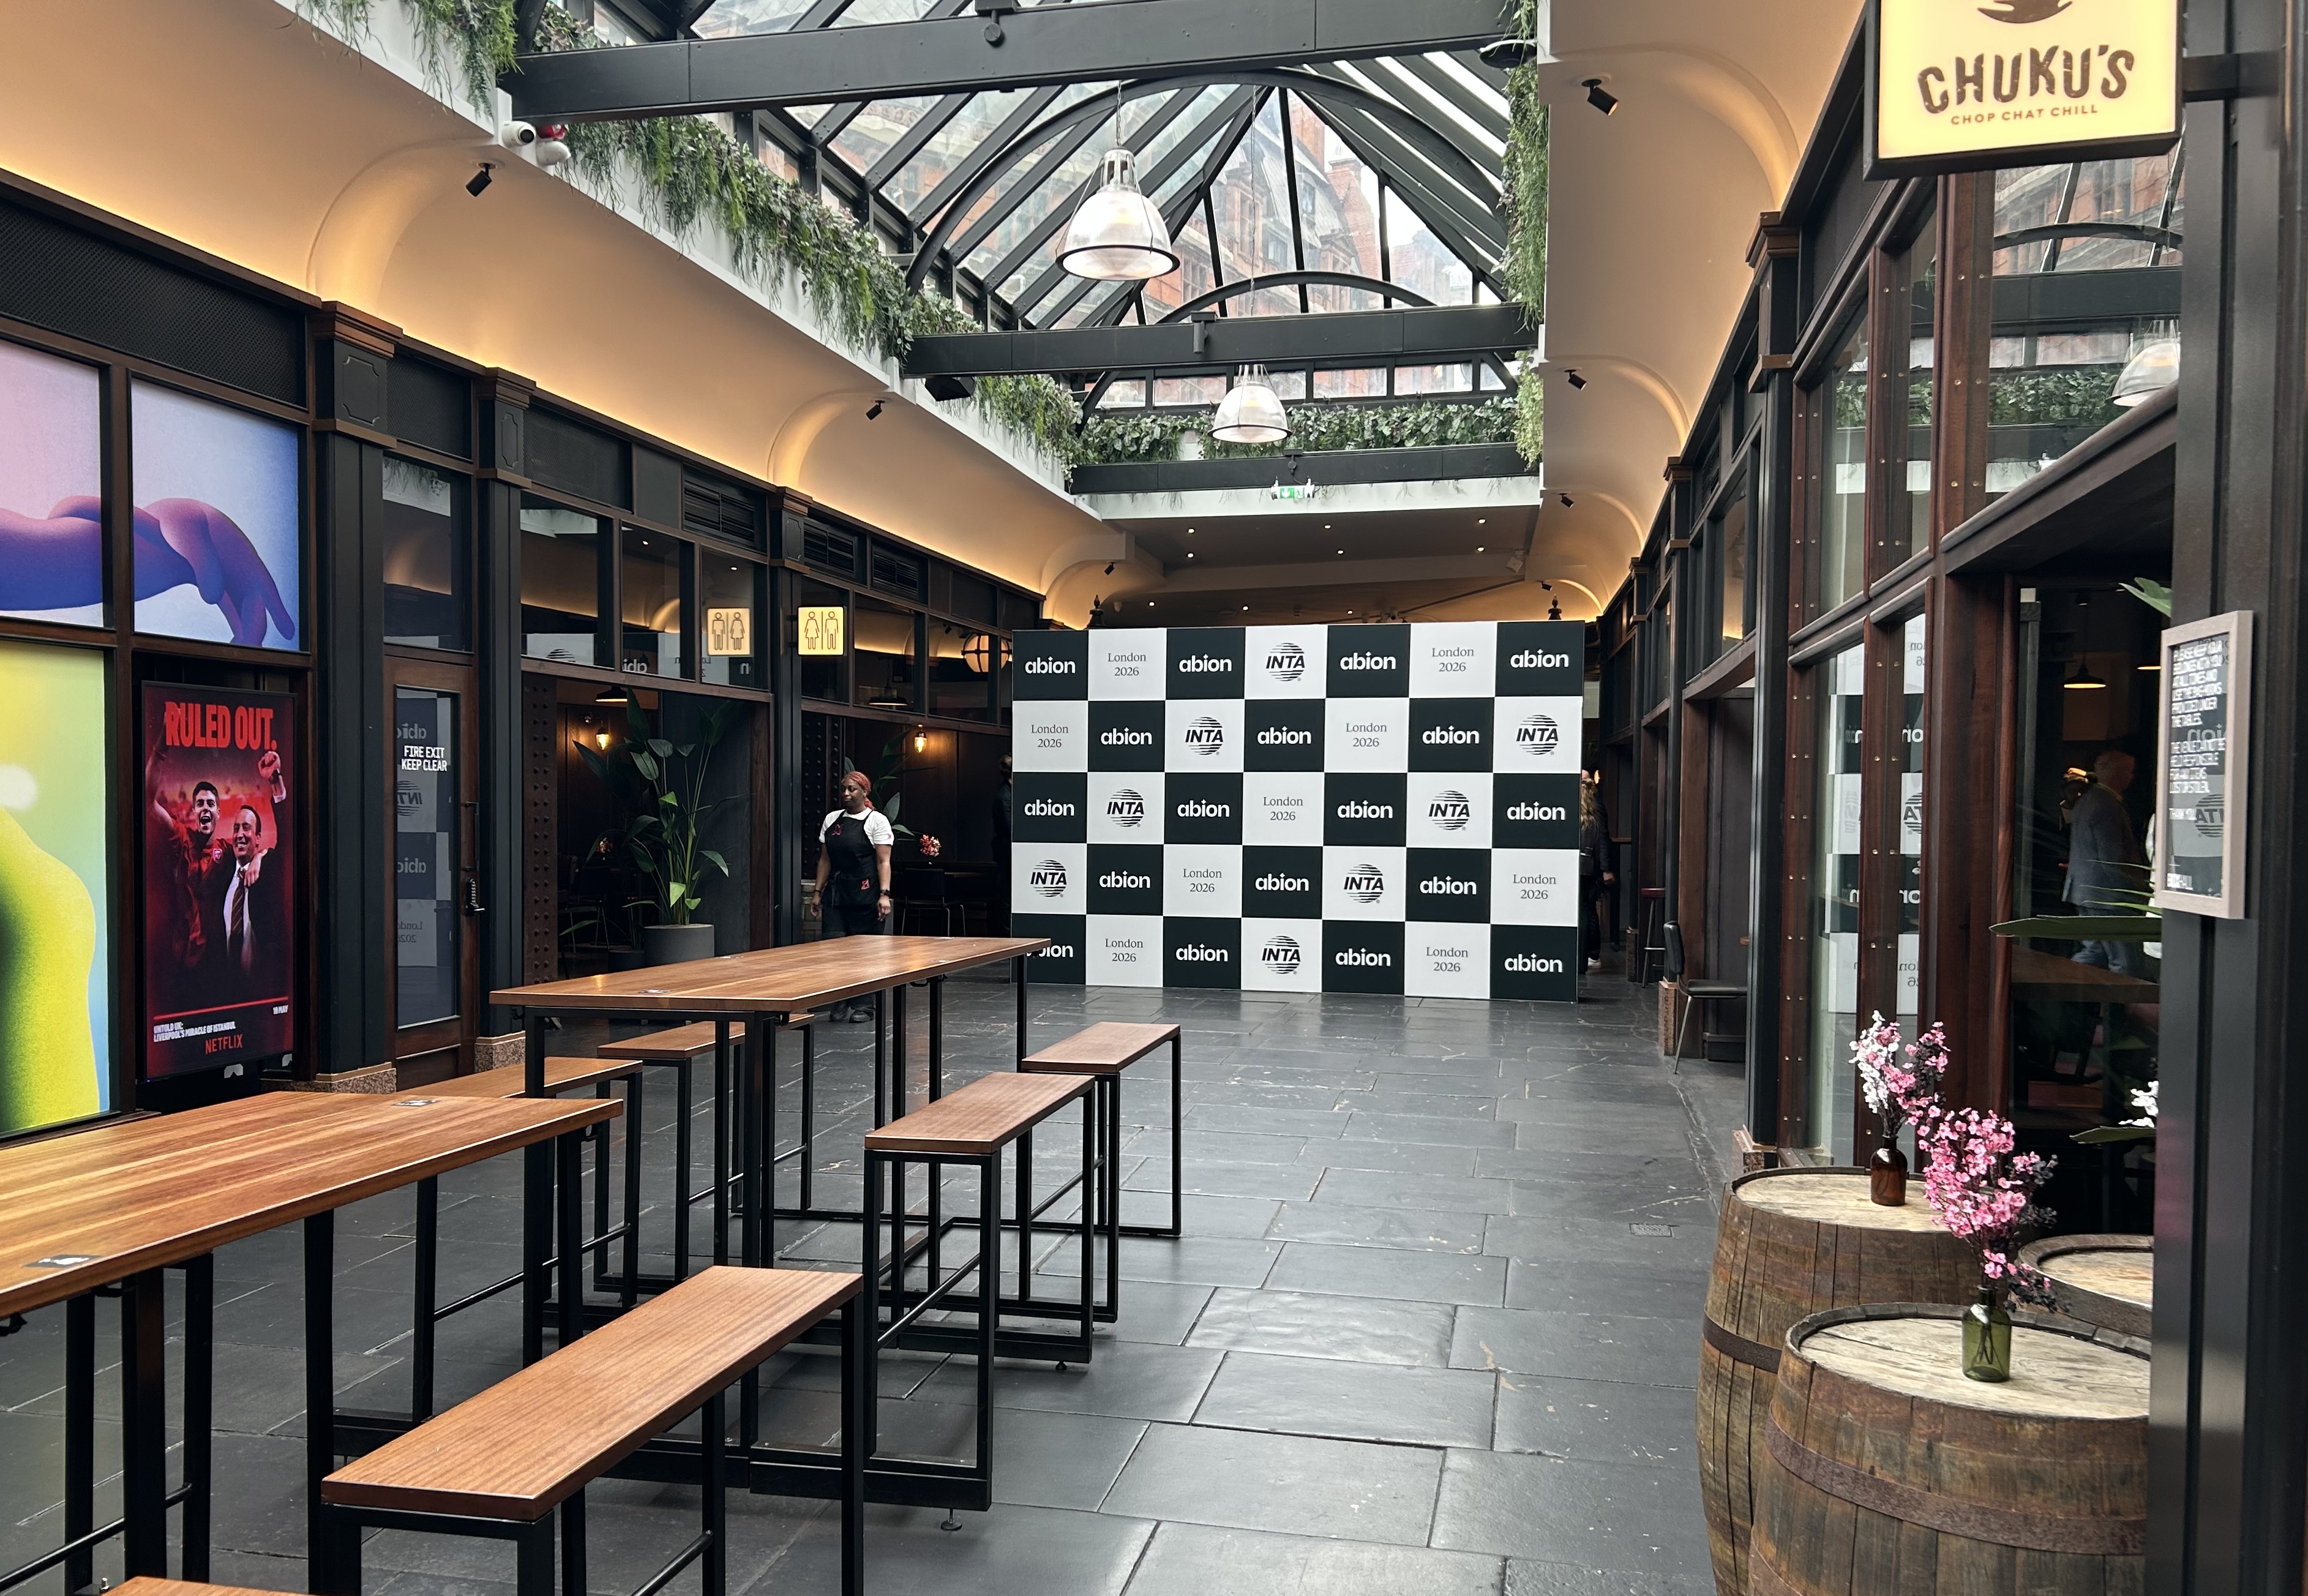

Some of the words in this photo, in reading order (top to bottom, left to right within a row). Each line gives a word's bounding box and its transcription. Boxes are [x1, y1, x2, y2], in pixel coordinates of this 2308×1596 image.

[1917, 45, 2135, 114] CHUKU'S
[1950, 113, 1995, 125] CHOP
[2001, 109, 2044, 121] CHAT
[2051, 104, 2098, 117] CHILL
[1108, 653, 1146, 662] London
[1433, 647, 1474, 657] London
[1510, 649, 1569, 668] abion
[1025, 656, 1075, 673] abion
[1179, 654, 1232, 672] abion
[1266, 655, 1305, 669] INTA
[1340, 651, 1396, 670] abion
[1439, 662, 1466, 672] 2026
[1115, 667, 1139, 676] 2026
[165, 702, 231, 747] RULED
[234, 706, 277, 751] OUT.
[1032, 724, 1068, 733] London
[1346, 723, 1387, 732] London
[1101, 727, 1152, 744] abion
[1185, 729, 1223, 743] INTA
[1257, 726, 1311, 744] abion
[1423, 725, 1479, 744] abion
[1516, 728, 1558, 742] INTA
[1038, 739, 1062, 747] 2026
[1353, 738, 1379, 747] 2026
[404, 745, 424, 758] FIRE
[425, 746, 445, 759] EXIT
[401, 759, 422, 771] KEEP
[422, 759, 448, 771] CLEAR
[1025, 798, 1074, 815] abion
[1107, 801, 1144, 815] INTA
[1264, 796, 1303, 806] London
[1178, 800, 1229, 817] abion
[1270, 811, 1295, 820] 2026
[1338, 800, 1393, 819] abion
[1429, 803, 1470, 817] INTA
[1507, 801, 1565, 820] abion
[1030, 872, 1066, 885] INTA
[1100, 871, 1150, 888] abion
[1183, 869, 1222, 878] London
[1513, 874, 1556, 884] London
[1190, 883, 1215, 892] 2026
[1256, 873, 1309, 891] abion
[1344, 877, 1384, 891] INTA
[1420, 875, 1477, 894] abion
[1521, 890, 1548, 899] 2026
[1105, 938, 1143, 948] London
[1026, 945, 1073, 957] ion
[1112, 953, 1136, 962] 2026
[1176, 943, 1227, 962] abion
[1262, 948, 1300, 962] INTA
[1336, 948, 1390, 966] abion
[1426, 947, 1468, 957] London
[1434, 962, 1460, 972] 2026
[1505, 953, 1562, 973] abion
[185, 1026, 206, 1037] MIRACLE
[206, 1025, 213, 1033] OF
[205, 1033, 243, 1055] NETFLIX
